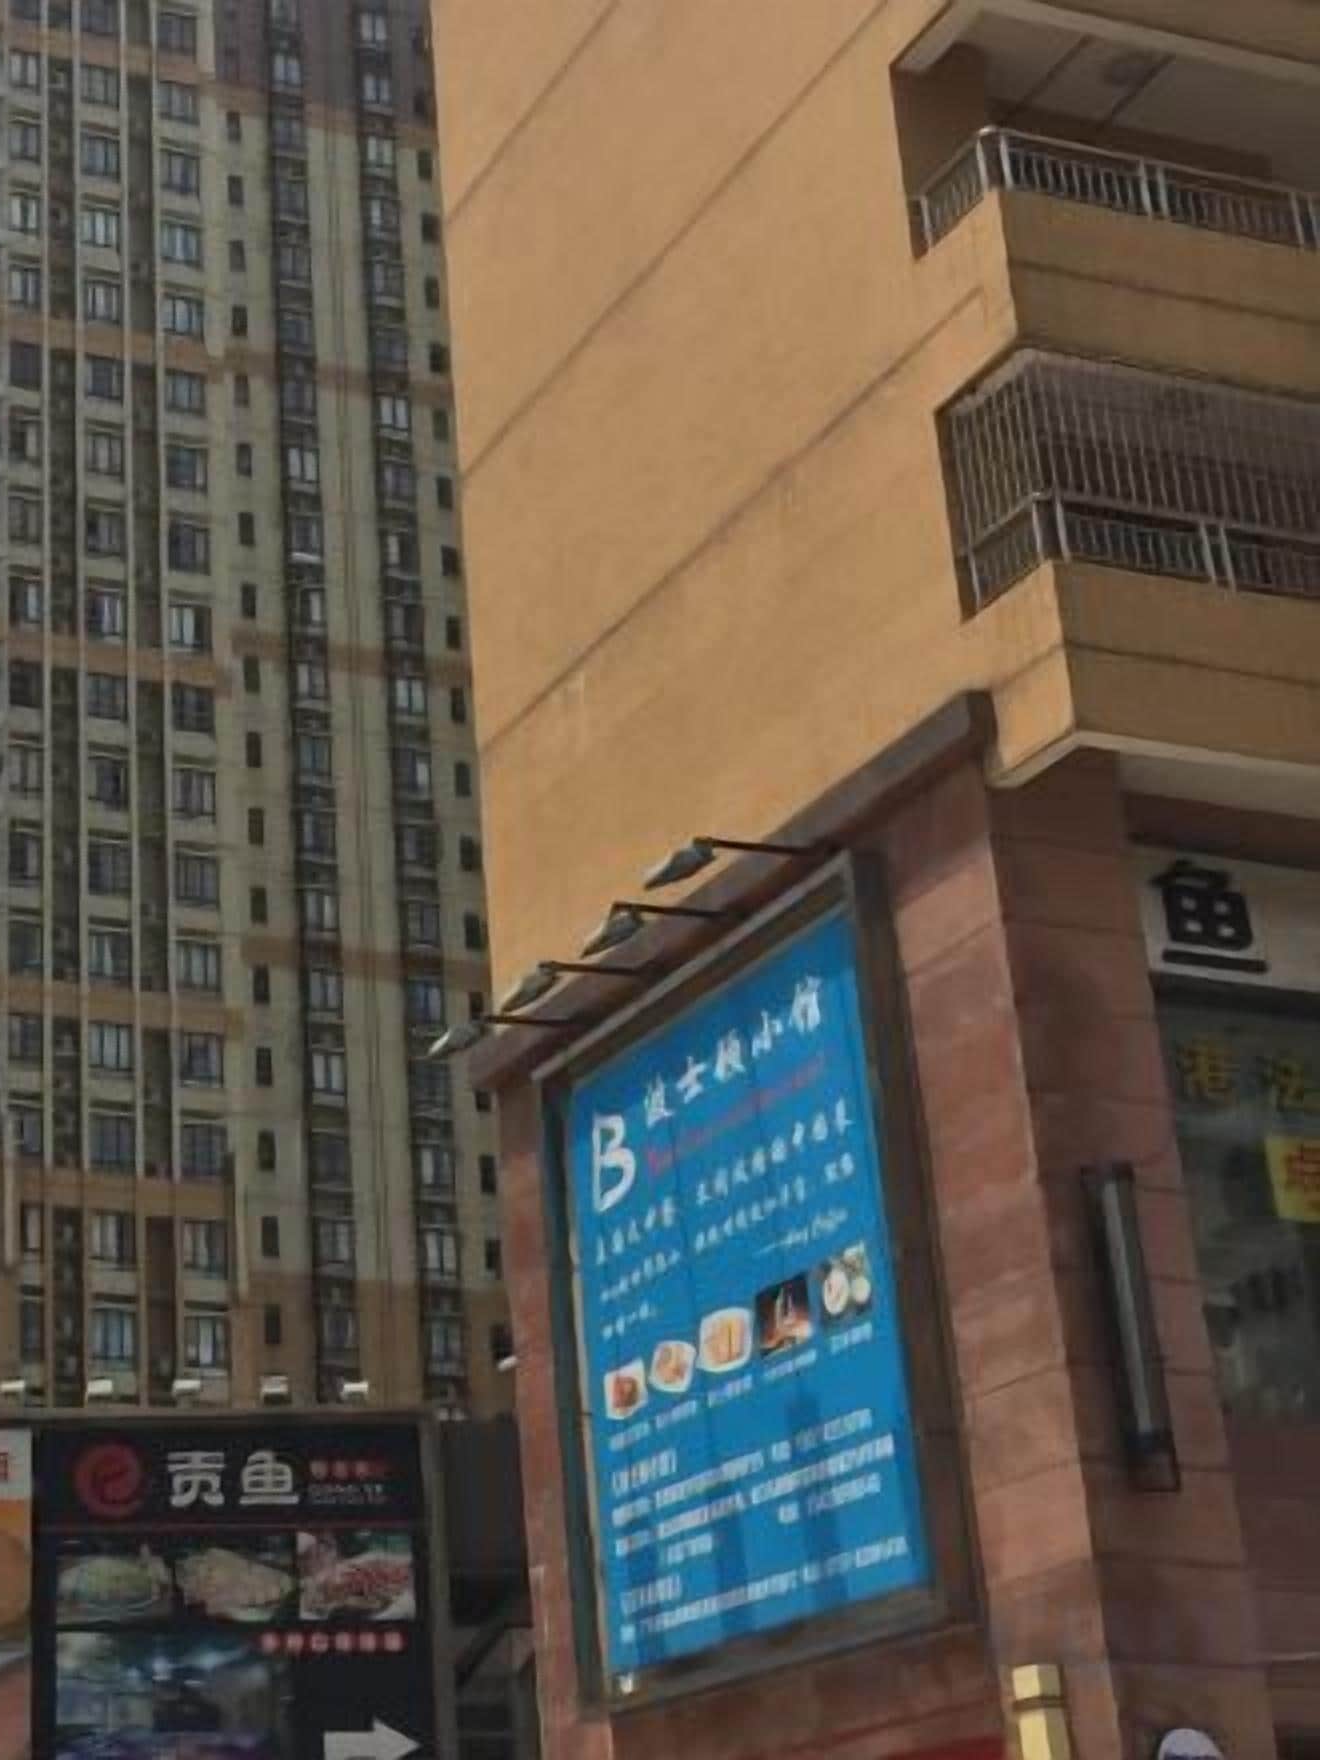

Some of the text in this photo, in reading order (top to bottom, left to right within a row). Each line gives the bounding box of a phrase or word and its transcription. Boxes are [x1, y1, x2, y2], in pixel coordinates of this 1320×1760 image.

[1146, 858, 1270, 974] 鱼
[591, 1112, 636, 1214] B
[167, 1450, 301, 1508] 贡鱼
